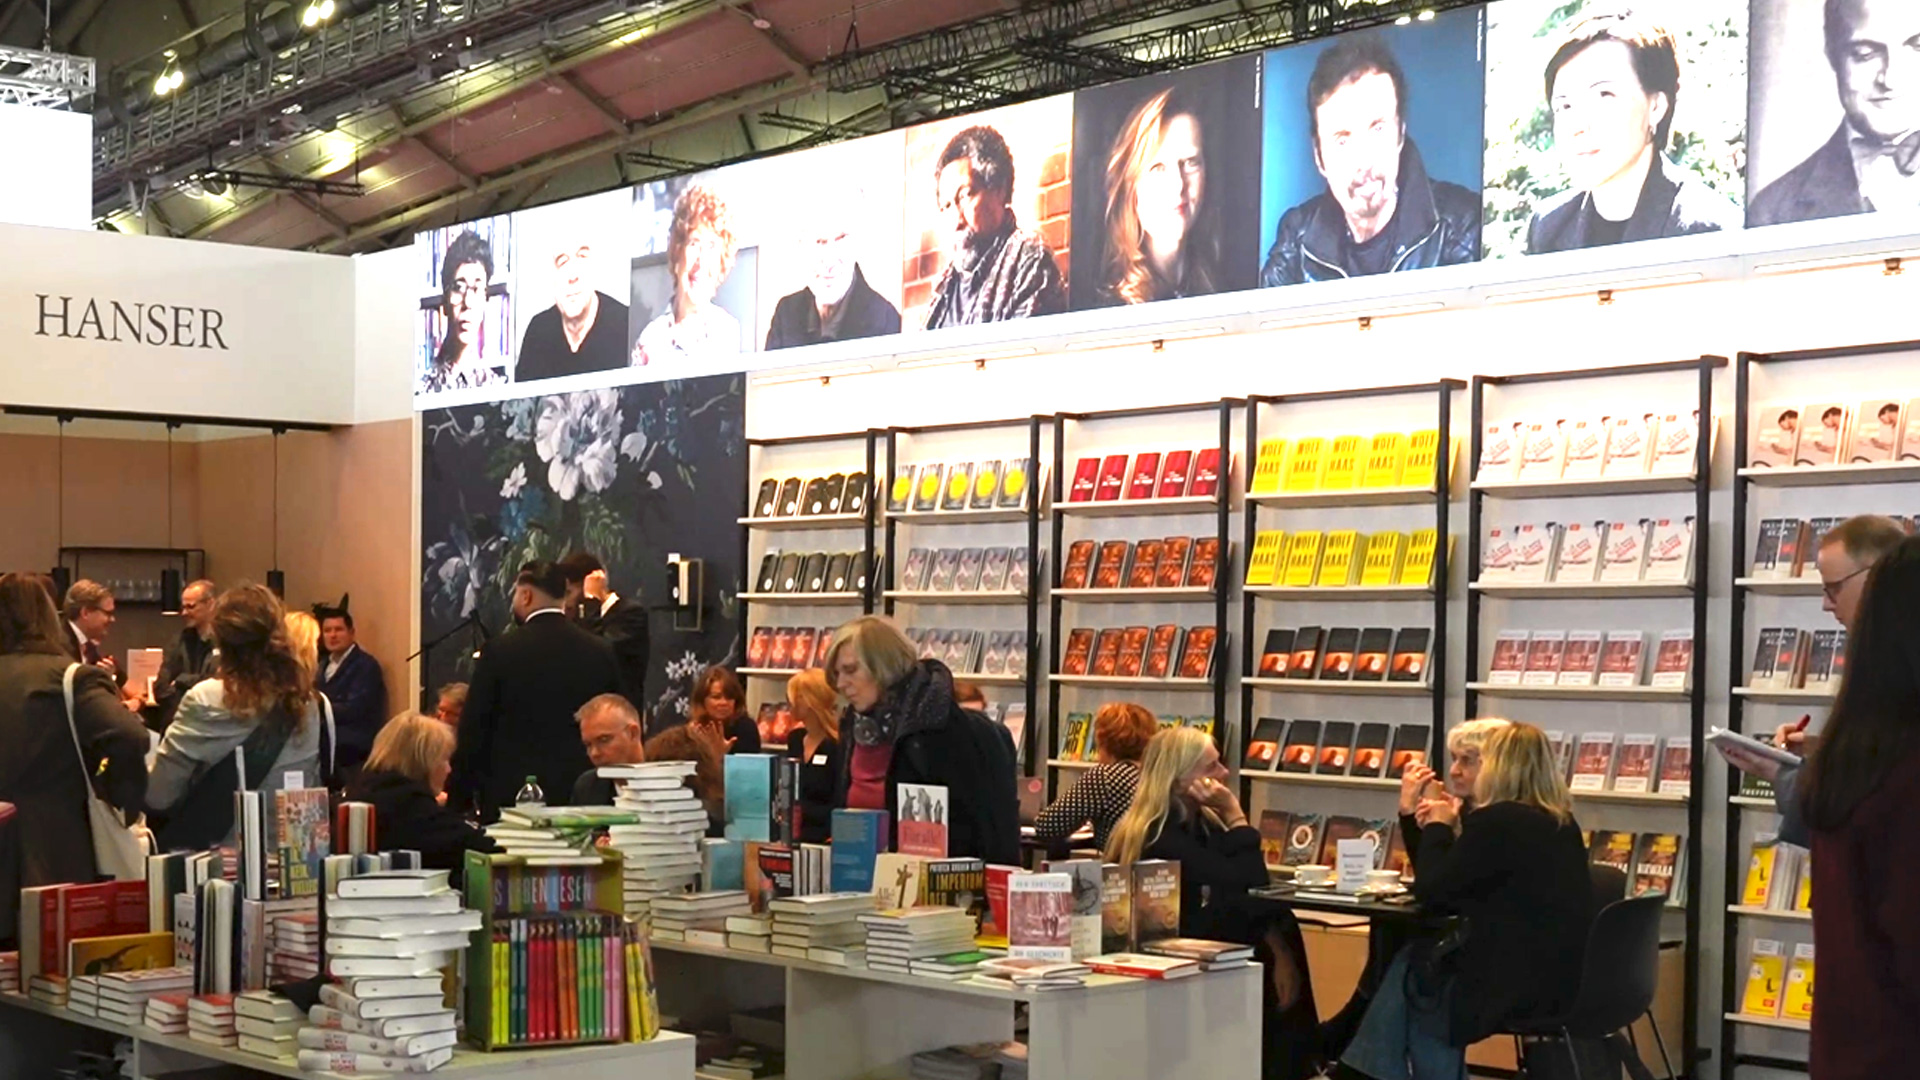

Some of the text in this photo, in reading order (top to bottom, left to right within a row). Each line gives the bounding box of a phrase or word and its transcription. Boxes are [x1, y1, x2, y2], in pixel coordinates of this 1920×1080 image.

[35, 294, 229, 350] HANSER
[1294, 460, 1318, 473] HAAS
[1329, 458, 1355, 472] HAAS
[1369, 456, 1394, 470] HAAS
[1407, 453, 1433, 467] HAAS
[1257, 461, 1280, 475] HAAS
[1253, 552, 1276, 566] HAAS
[1291, 553, 1314, 567] HAAS
[1324, 552, 1349, 566] HAAS
[1367, 553, 1391, 567] HAAS
[1407, 552, 1431, 566] HAAS
[936, 872, 984, 891] IMPERIUM
